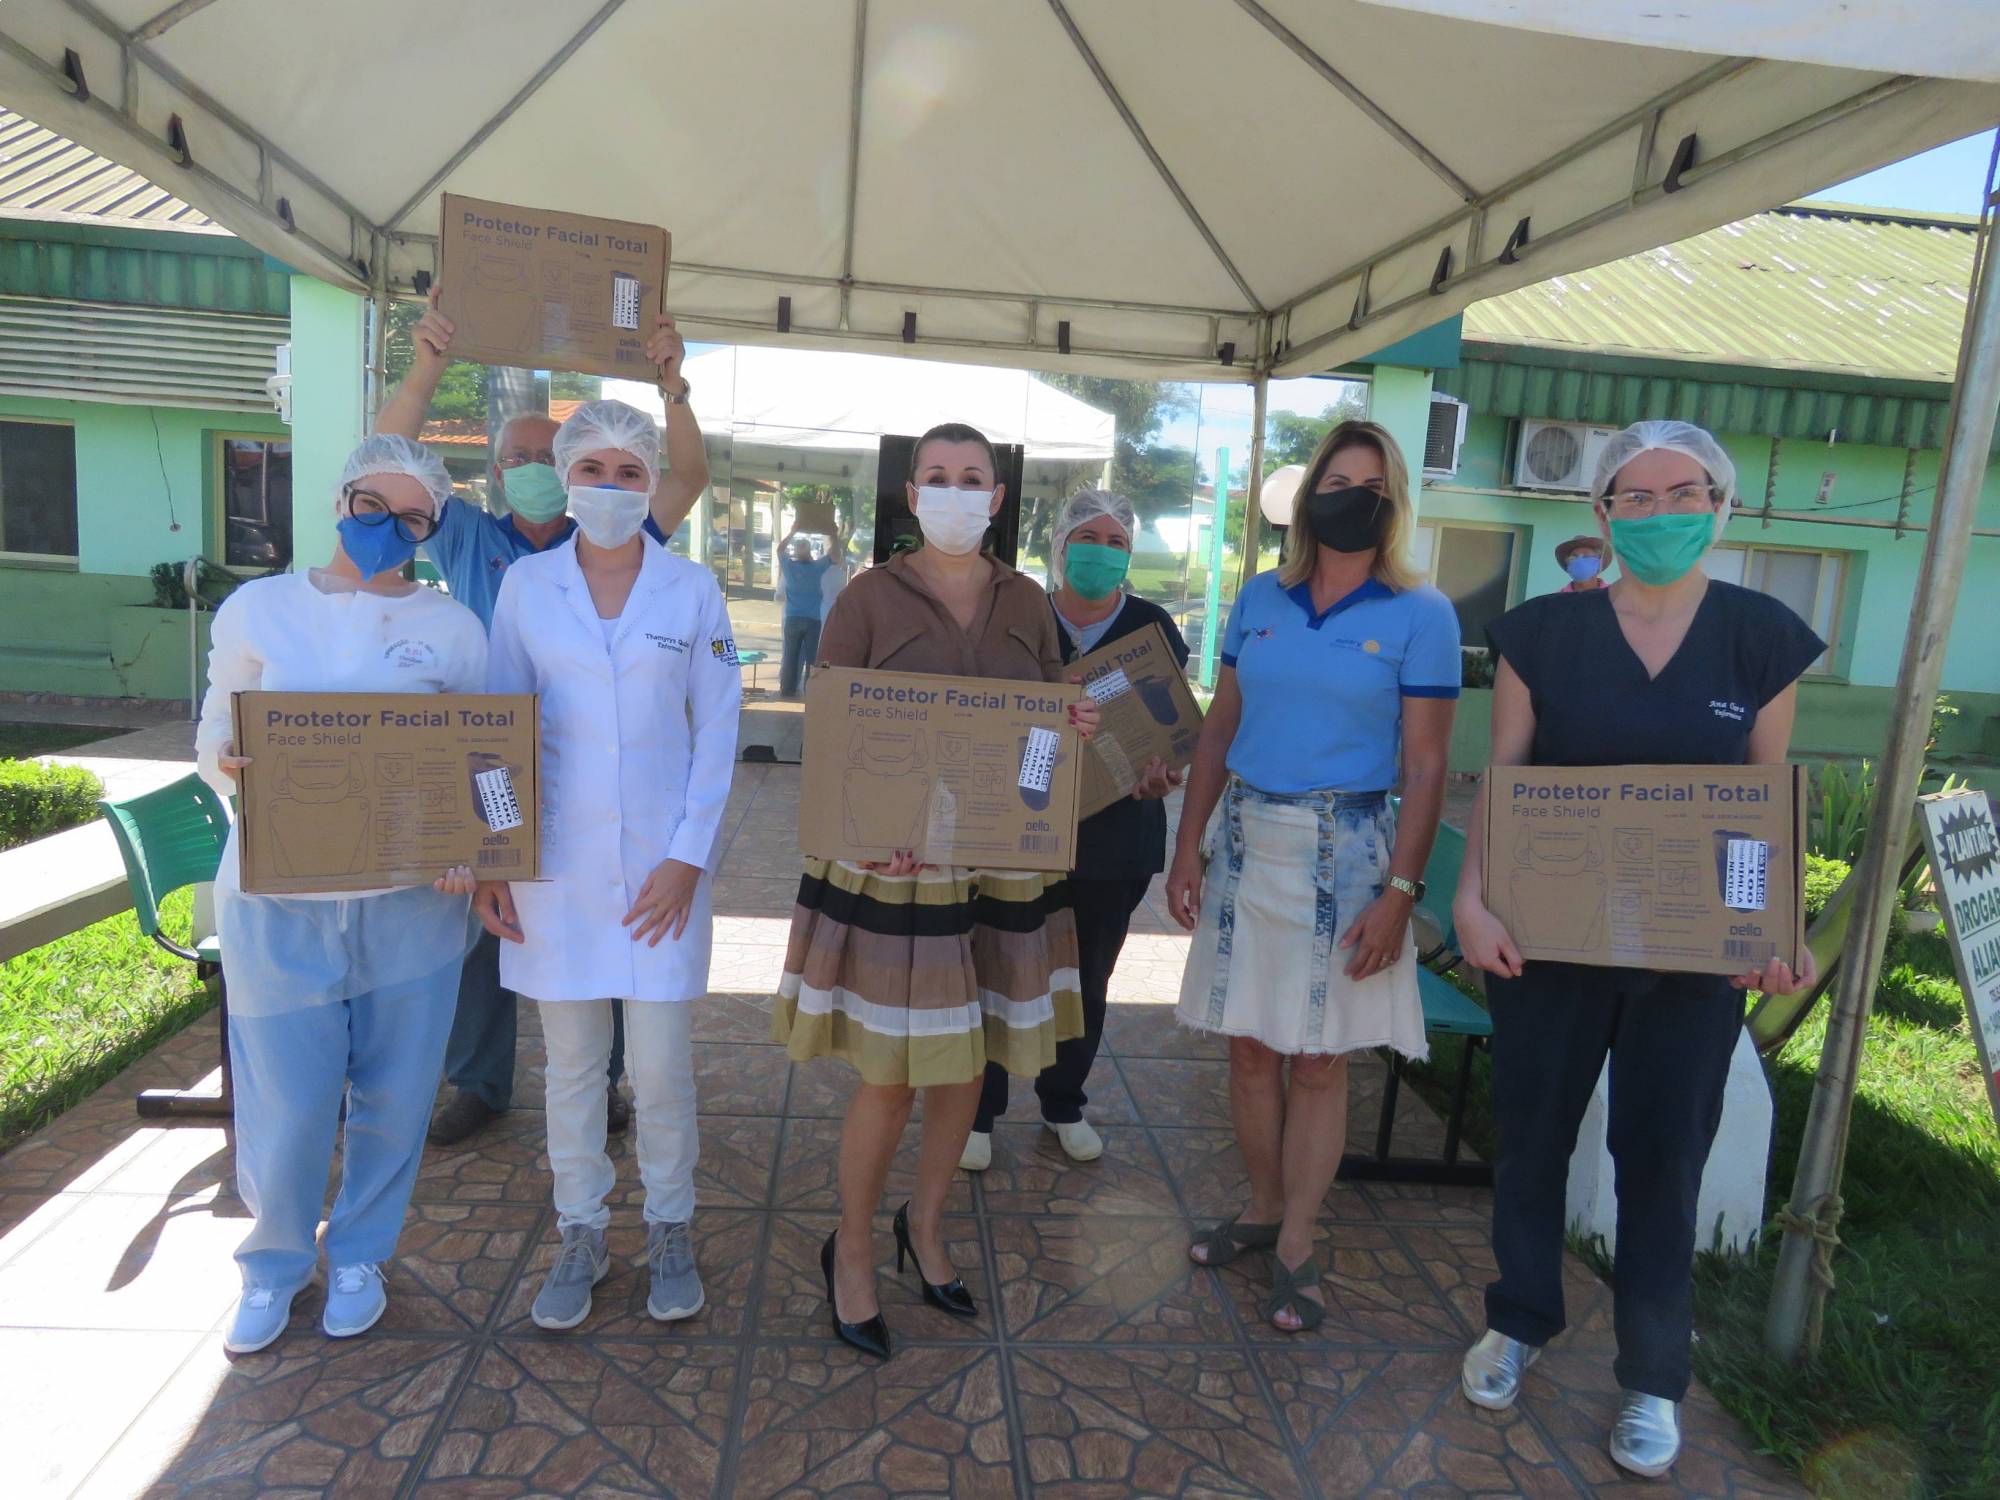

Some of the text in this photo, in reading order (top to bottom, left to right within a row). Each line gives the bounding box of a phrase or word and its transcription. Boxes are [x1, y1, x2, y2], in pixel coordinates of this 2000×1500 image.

[462, 230, 533, 250] Face Shield
[463, 212, 648, 254] Protetor Facial Total
[1114, 639, 1152, 667] Total
[848, 704, 928, 721] Face Shield
[849, 682, 1063, 714] Protetor Facial Total
[267, 710, 515, 728] Protetor Facial Total
[267, 732, 362, 746] Face Shield
[1033, 753, 1046, 785] 100
[1513, 783, 1769, 802] Protetor Facial Total
[499, 792, 512, 824] 100
[1512, 804, 1601, 819] Face Shield
[1945, 820, 1992, 864] PLANTÃO
[1726, 861, 1734, 904] NEXTLOG
[1746, 865, 1754, 903] 100
